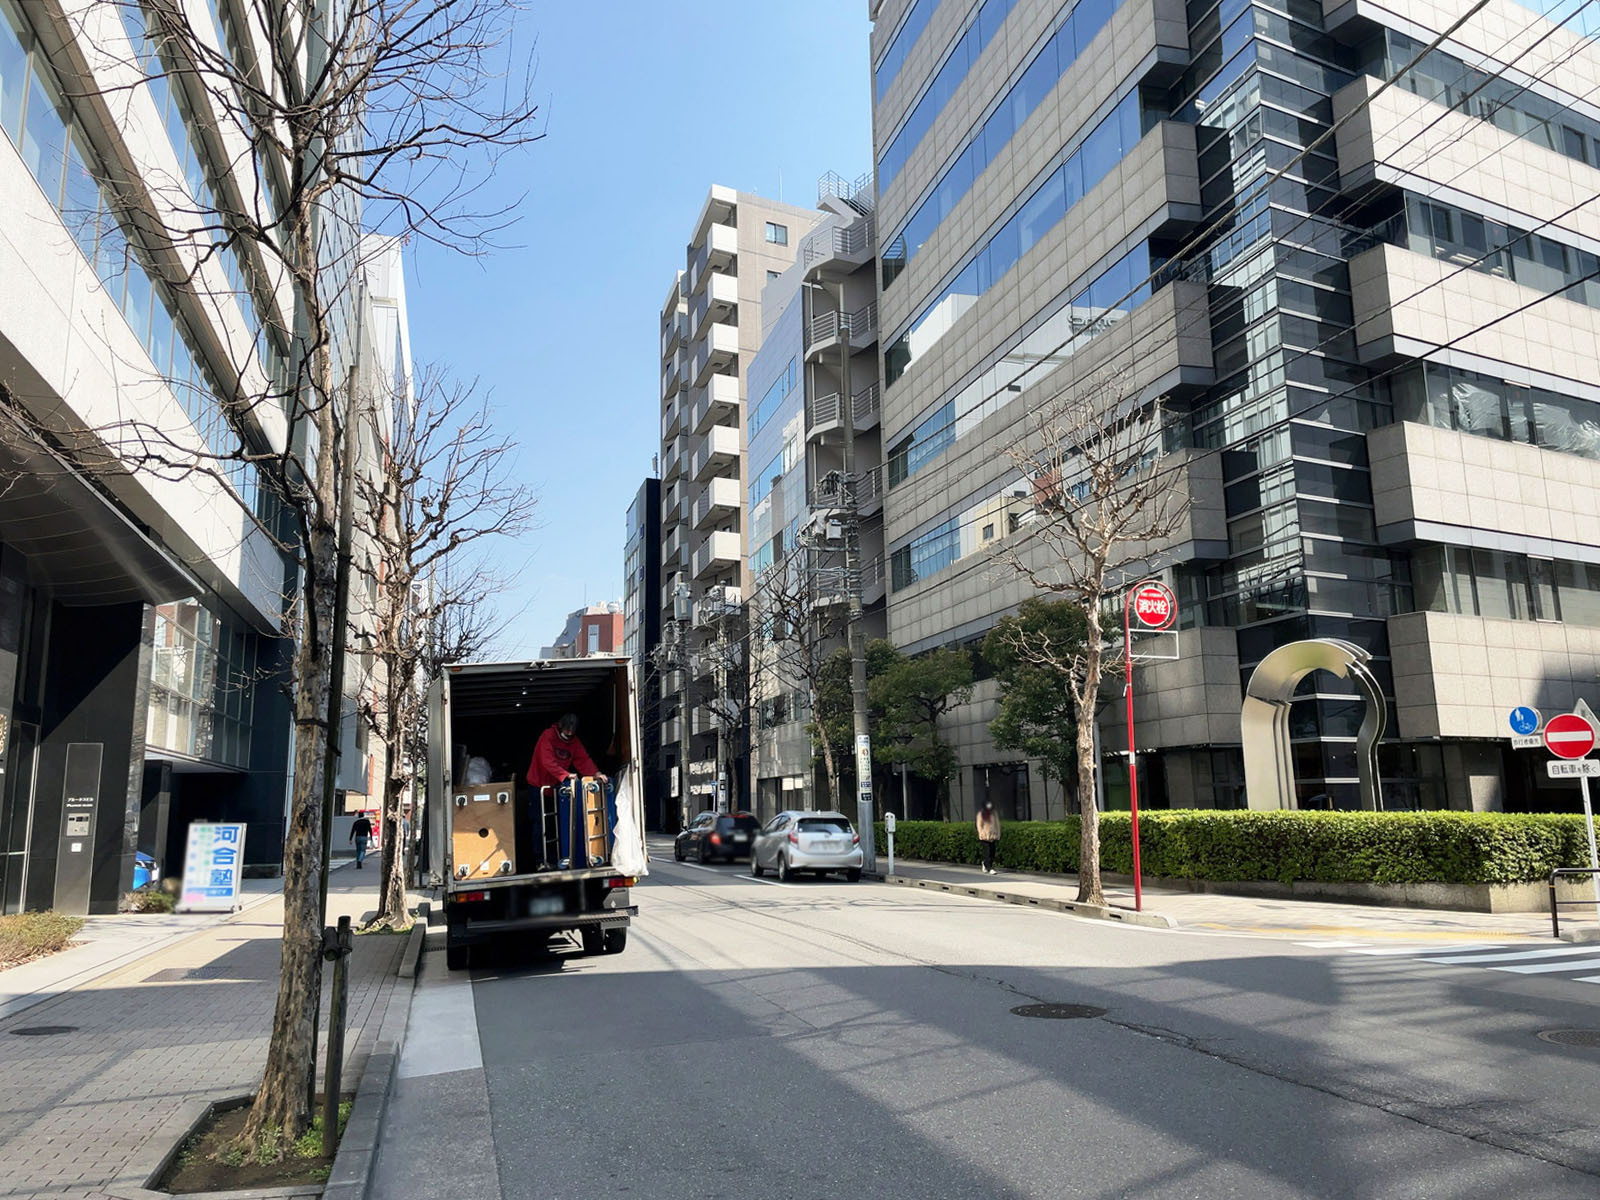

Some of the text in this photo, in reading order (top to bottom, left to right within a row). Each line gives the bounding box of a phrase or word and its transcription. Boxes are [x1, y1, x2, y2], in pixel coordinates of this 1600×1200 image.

[1139, 599, 1167, 614] 消火栓
[1552, 764, 1597, 775] 自転車を除く
[209, 826, 239, 886] 河合塾
